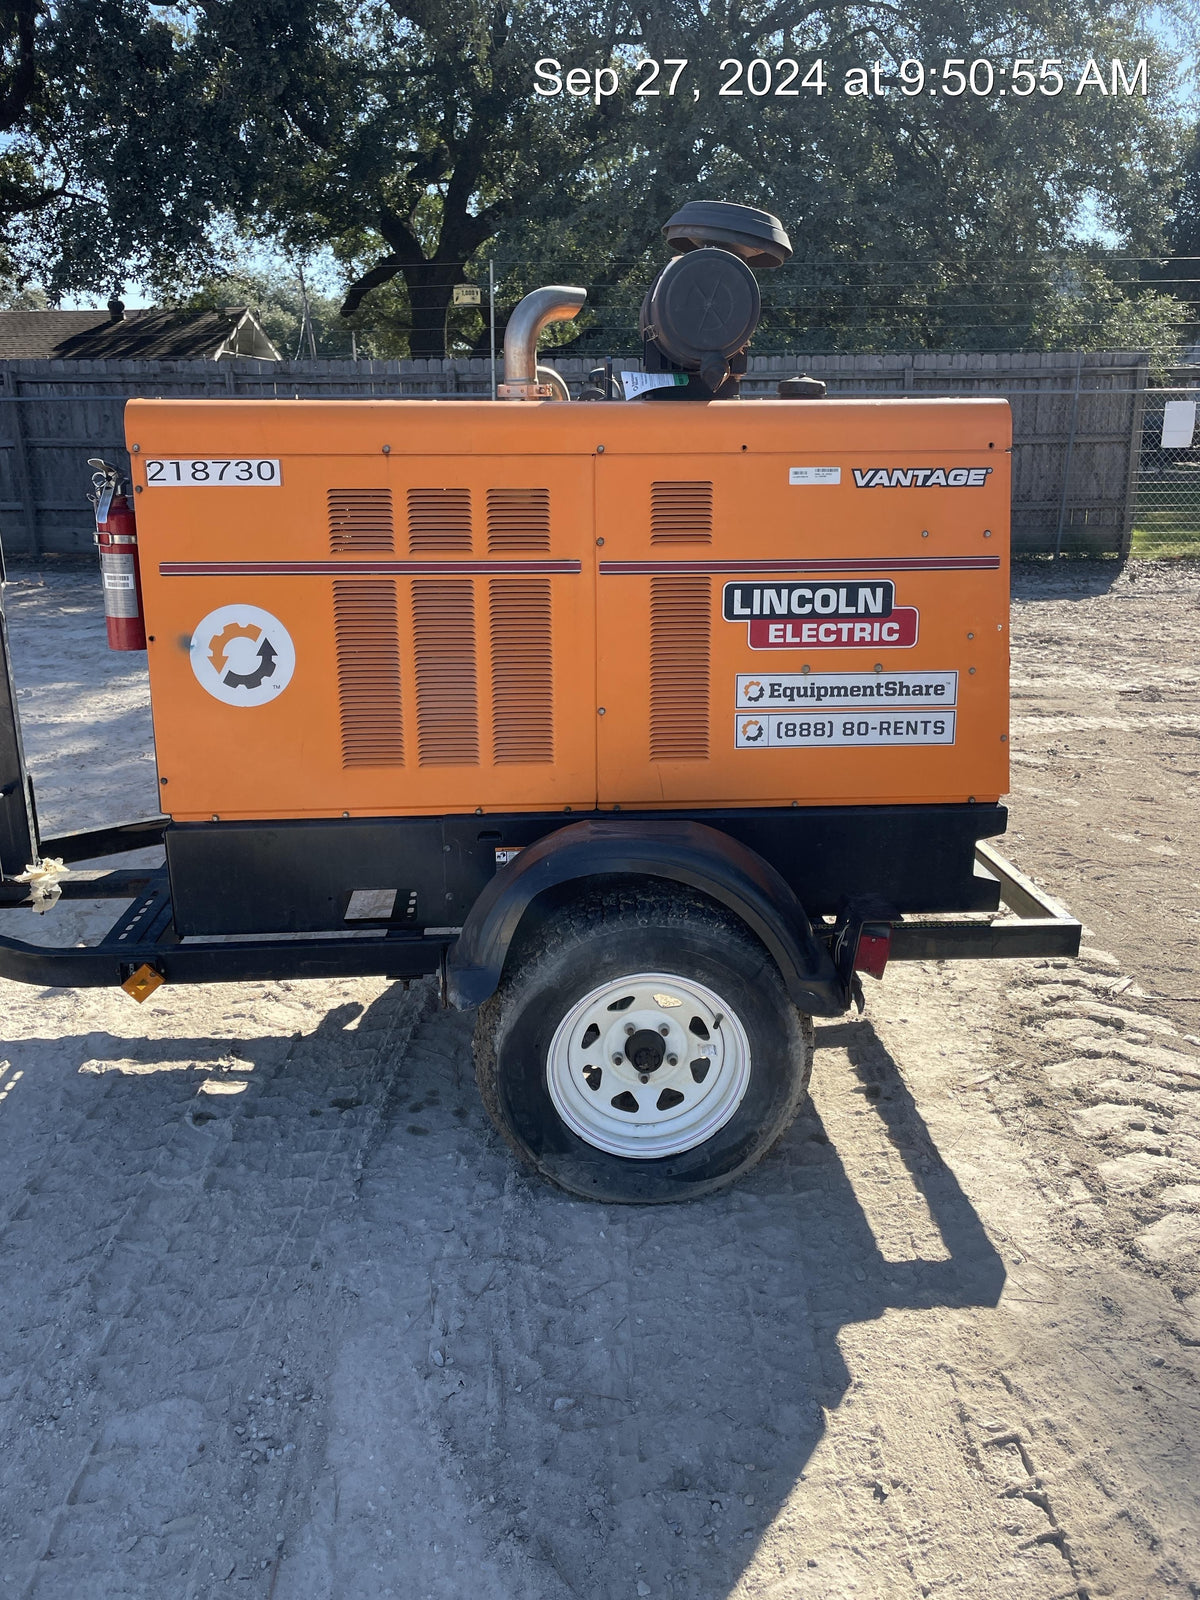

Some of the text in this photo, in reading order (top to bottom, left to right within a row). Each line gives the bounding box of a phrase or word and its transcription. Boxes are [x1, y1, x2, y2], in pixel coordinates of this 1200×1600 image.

[146, 460, 275, 481] 218730
[852, 468, 987, 487] VANTAGE
[733, 587, 884, 616] LINCOLN
[768, 622, 900, 643] ELECTRIC
[768, 681, 945, 702] EquipmentShare
[776, 720, 945, 739] (888) 80-RENTS
